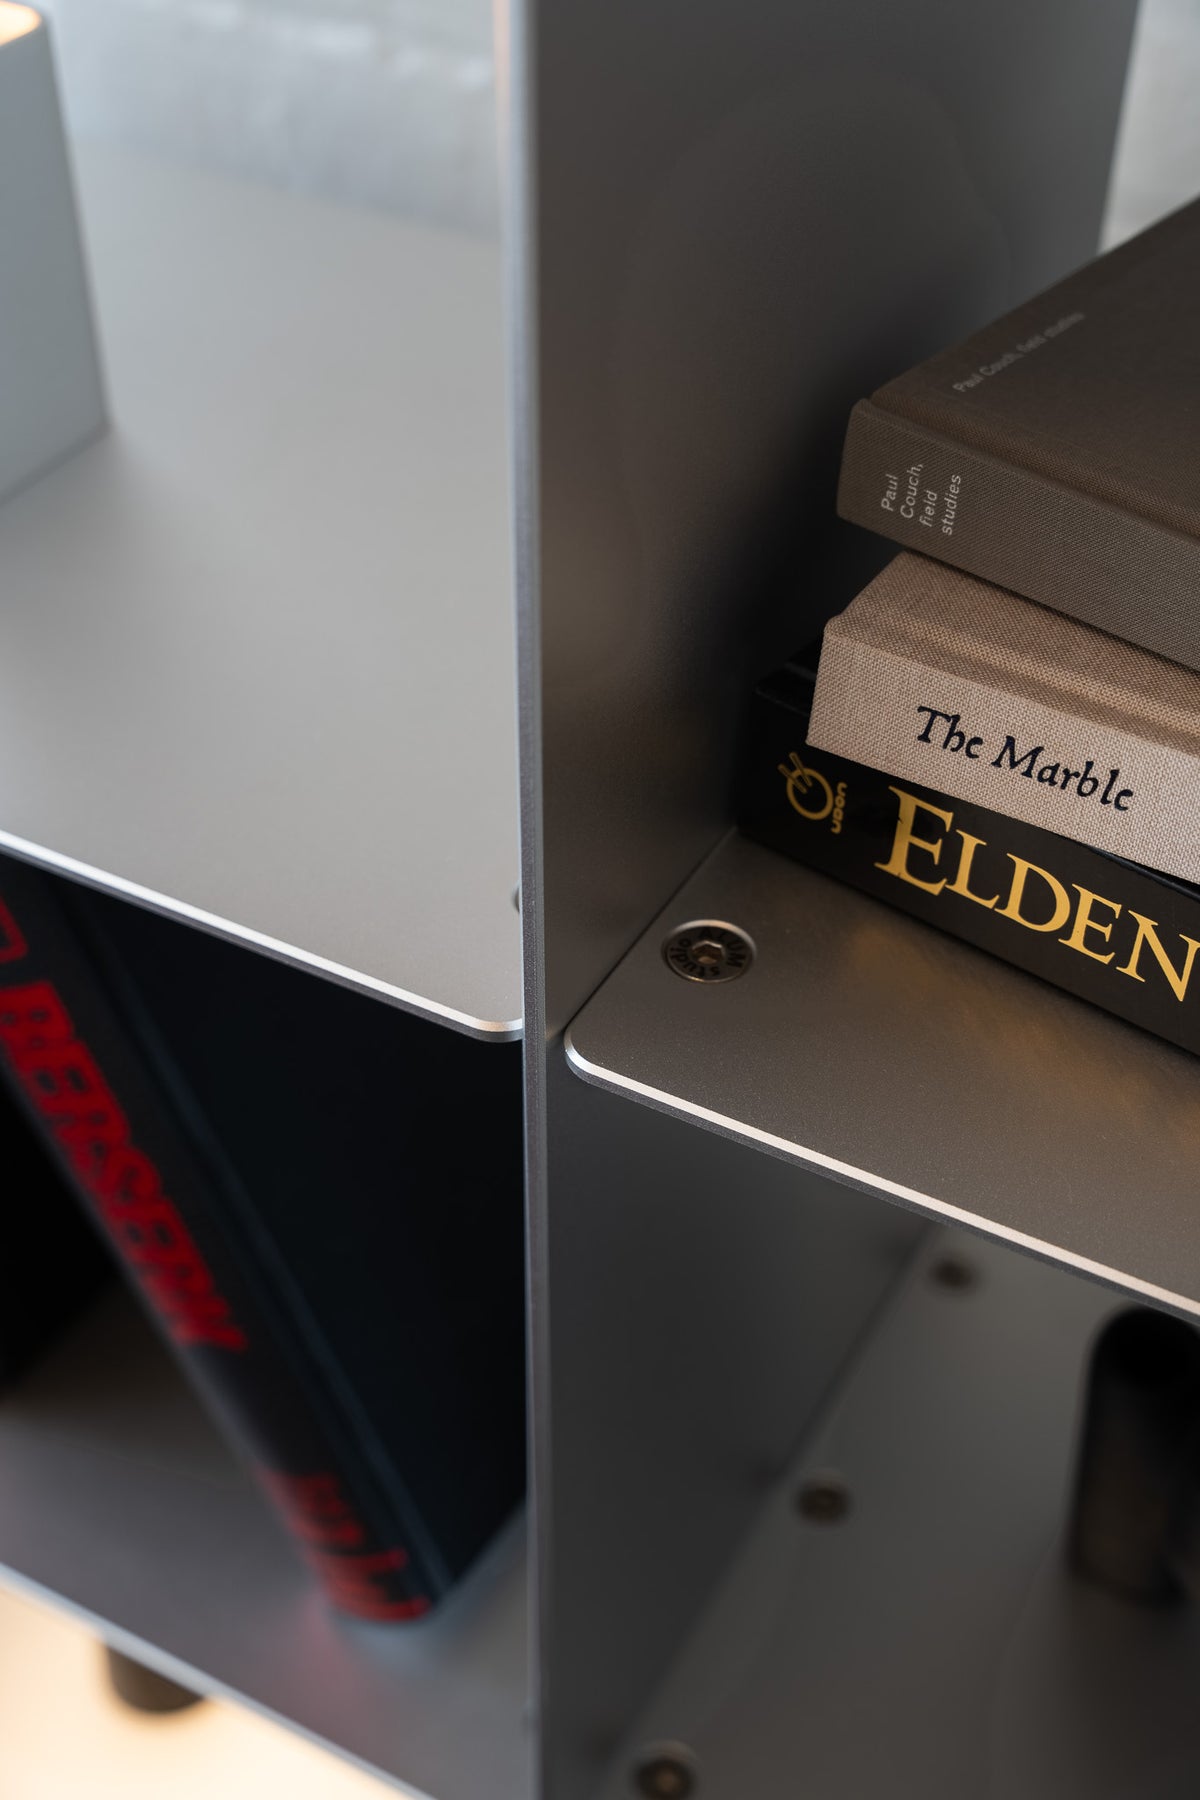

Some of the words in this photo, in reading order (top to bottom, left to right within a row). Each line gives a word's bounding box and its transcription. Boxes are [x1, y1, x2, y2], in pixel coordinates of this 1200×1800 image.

[881, 473, 899, 512] Paul
[900, 463, 924, 519] Couch,
[919, 490, 938, 528] field
[942, 474, 962, 536] studies
[917, 705, 984, 760] The
[991, 735, 1135, 811] Marble
[874, 785, 1200, 1002] ELDEN
